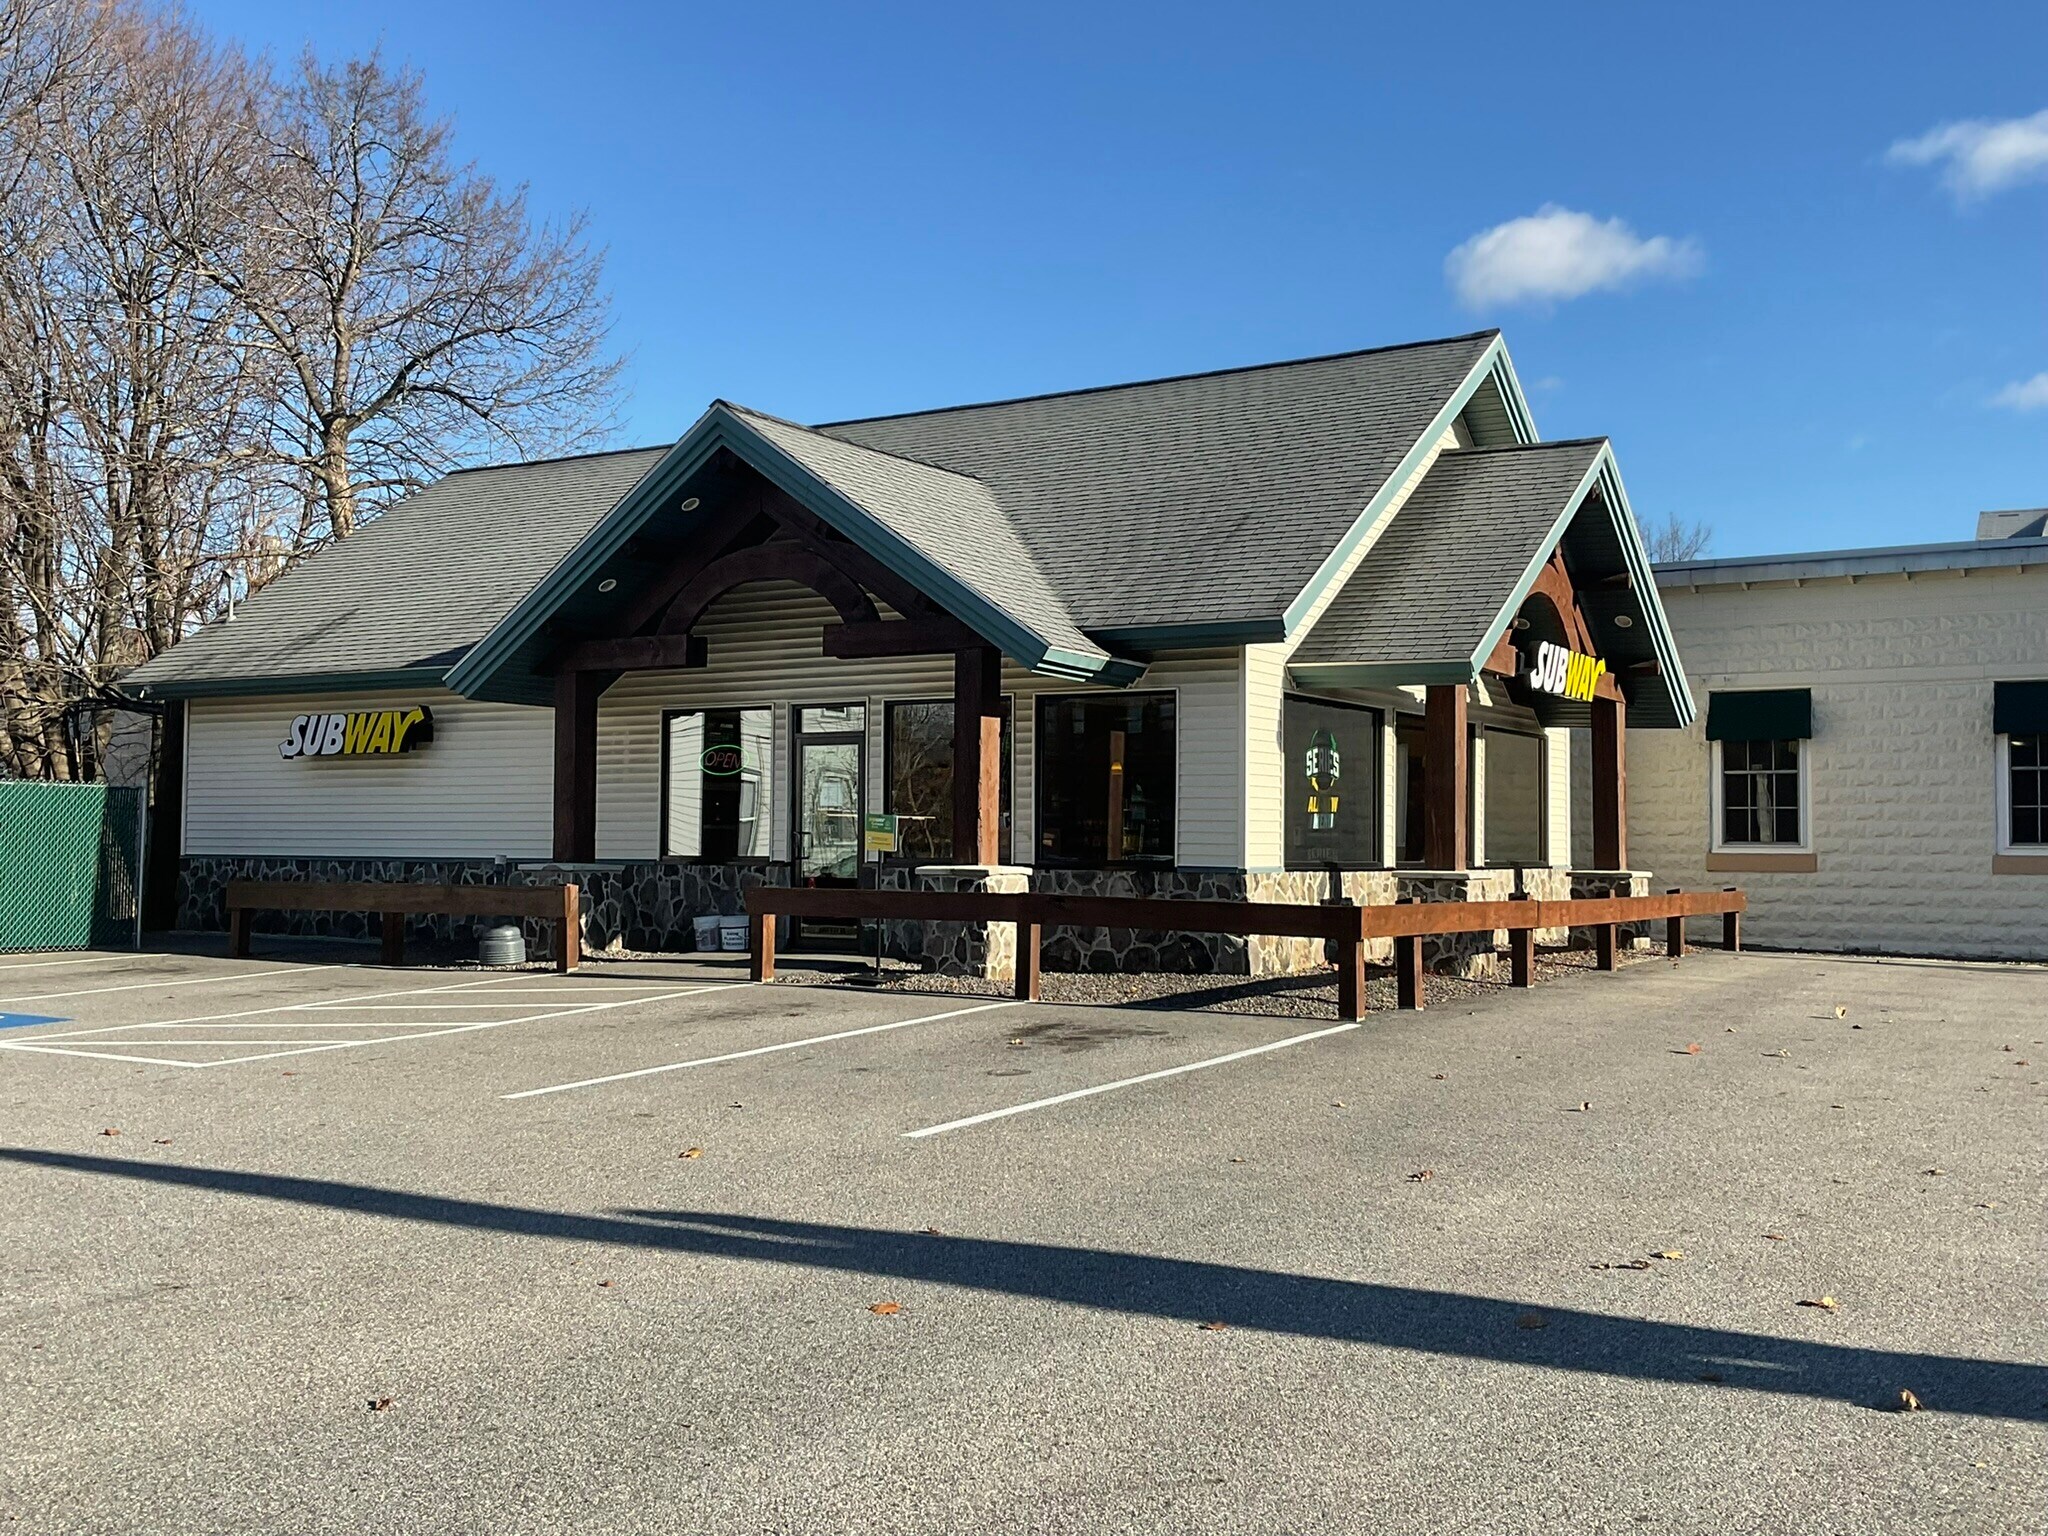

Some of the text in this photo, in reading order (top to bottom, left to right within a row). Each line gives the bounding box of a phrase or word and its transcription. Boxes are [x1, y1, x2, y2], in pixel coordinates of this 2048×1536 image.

[1530, 640, 1606, 702] SUBWAY
[278, 705, 425, 757] SUBWAY
[705, 751, 741, 768] OPEN
[1306, 747, 1340, 779] SERIES
